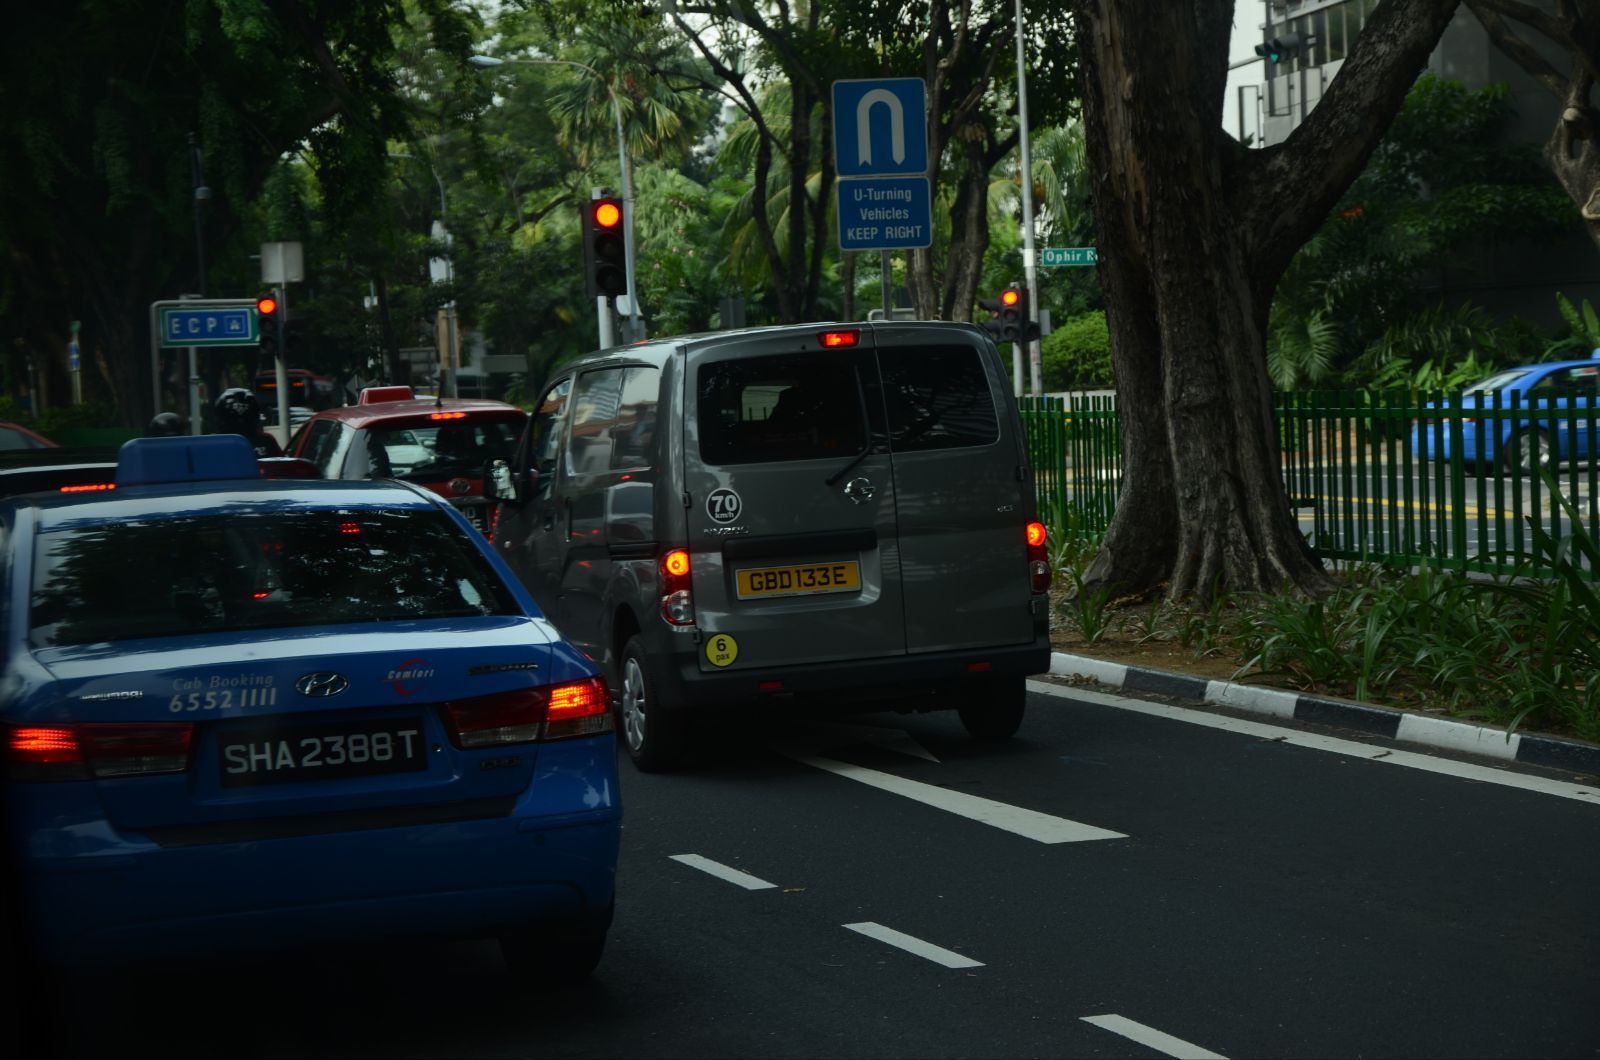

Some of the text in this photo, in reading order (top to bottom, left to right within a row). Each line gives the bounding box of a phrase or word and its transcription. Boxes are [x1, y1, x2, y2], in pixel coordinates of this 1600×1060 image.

[853, 187, 912, 203] U-Turning
[860, 207, 909, 221] Vehicles
[847, 225, 923, 241] KEEP RIGHT
[1046, 250, 1081, 264] Ophir
[711, 494, 737, 513] 70
[750, 566, 847, 591] GBD133E
[716, 638, 726, 652] 6
[716, 653, 729, 663] pax
[386, 669, 435, 680] Comfort
[172, 675, 273, 691] Cab Booking
[224, 729, 418, 774] SHA2388T
